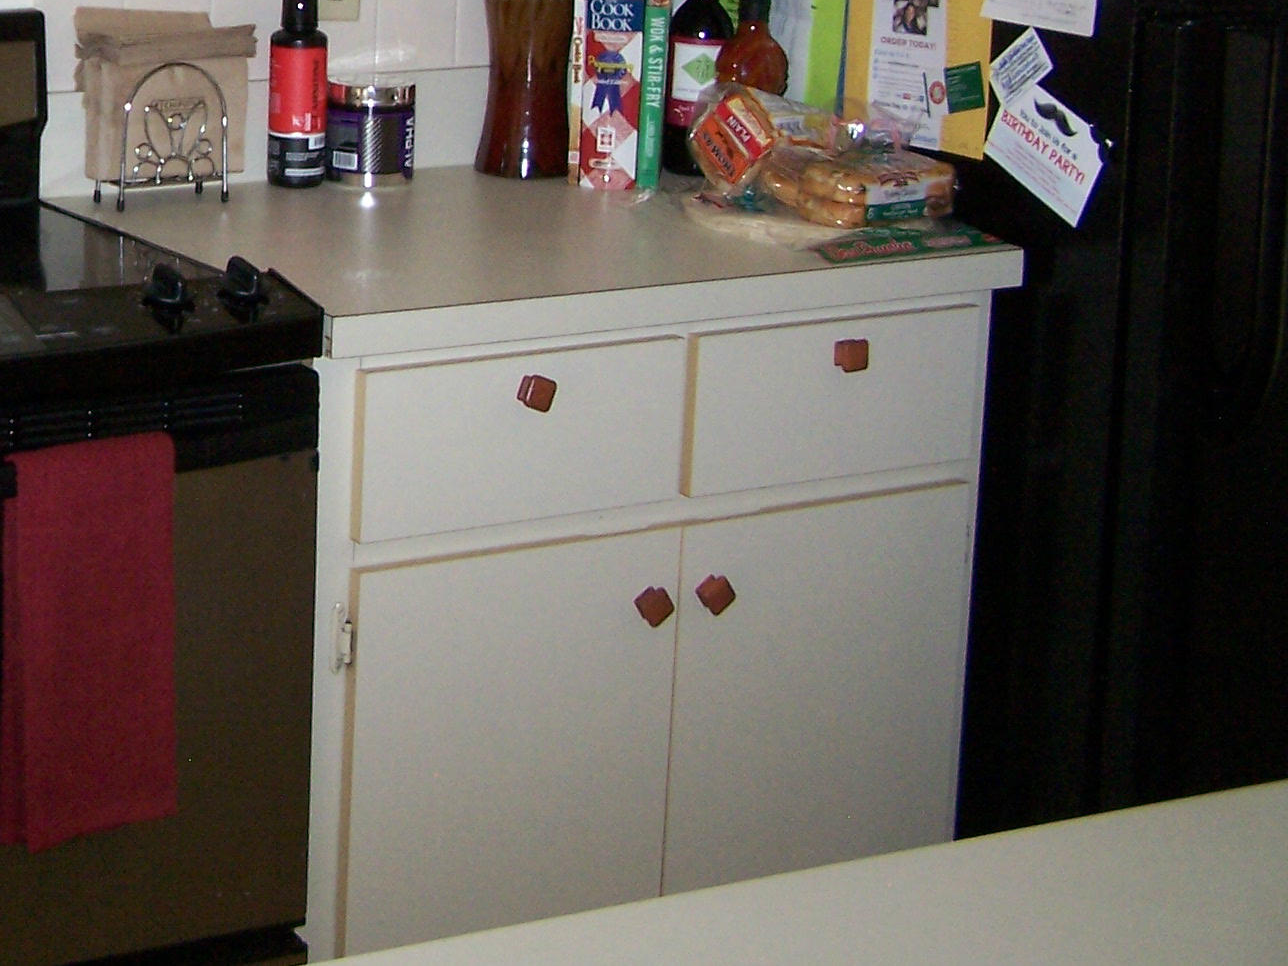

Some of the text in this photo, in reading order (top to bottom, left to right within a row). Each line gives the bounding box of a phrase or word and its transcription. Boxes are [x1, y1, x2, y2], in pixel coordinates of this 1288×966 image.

[591, 14, 633, 32] BOOK
[649, 16, 666, 43] WOK
[645, 56, 664, 109] STIR-FRY
[726, 115, 752, 143] PLAIN
[1000, 108, 1050, 155] BIRTHDAY
[1048, 148, 1086, 186] PARTY!
